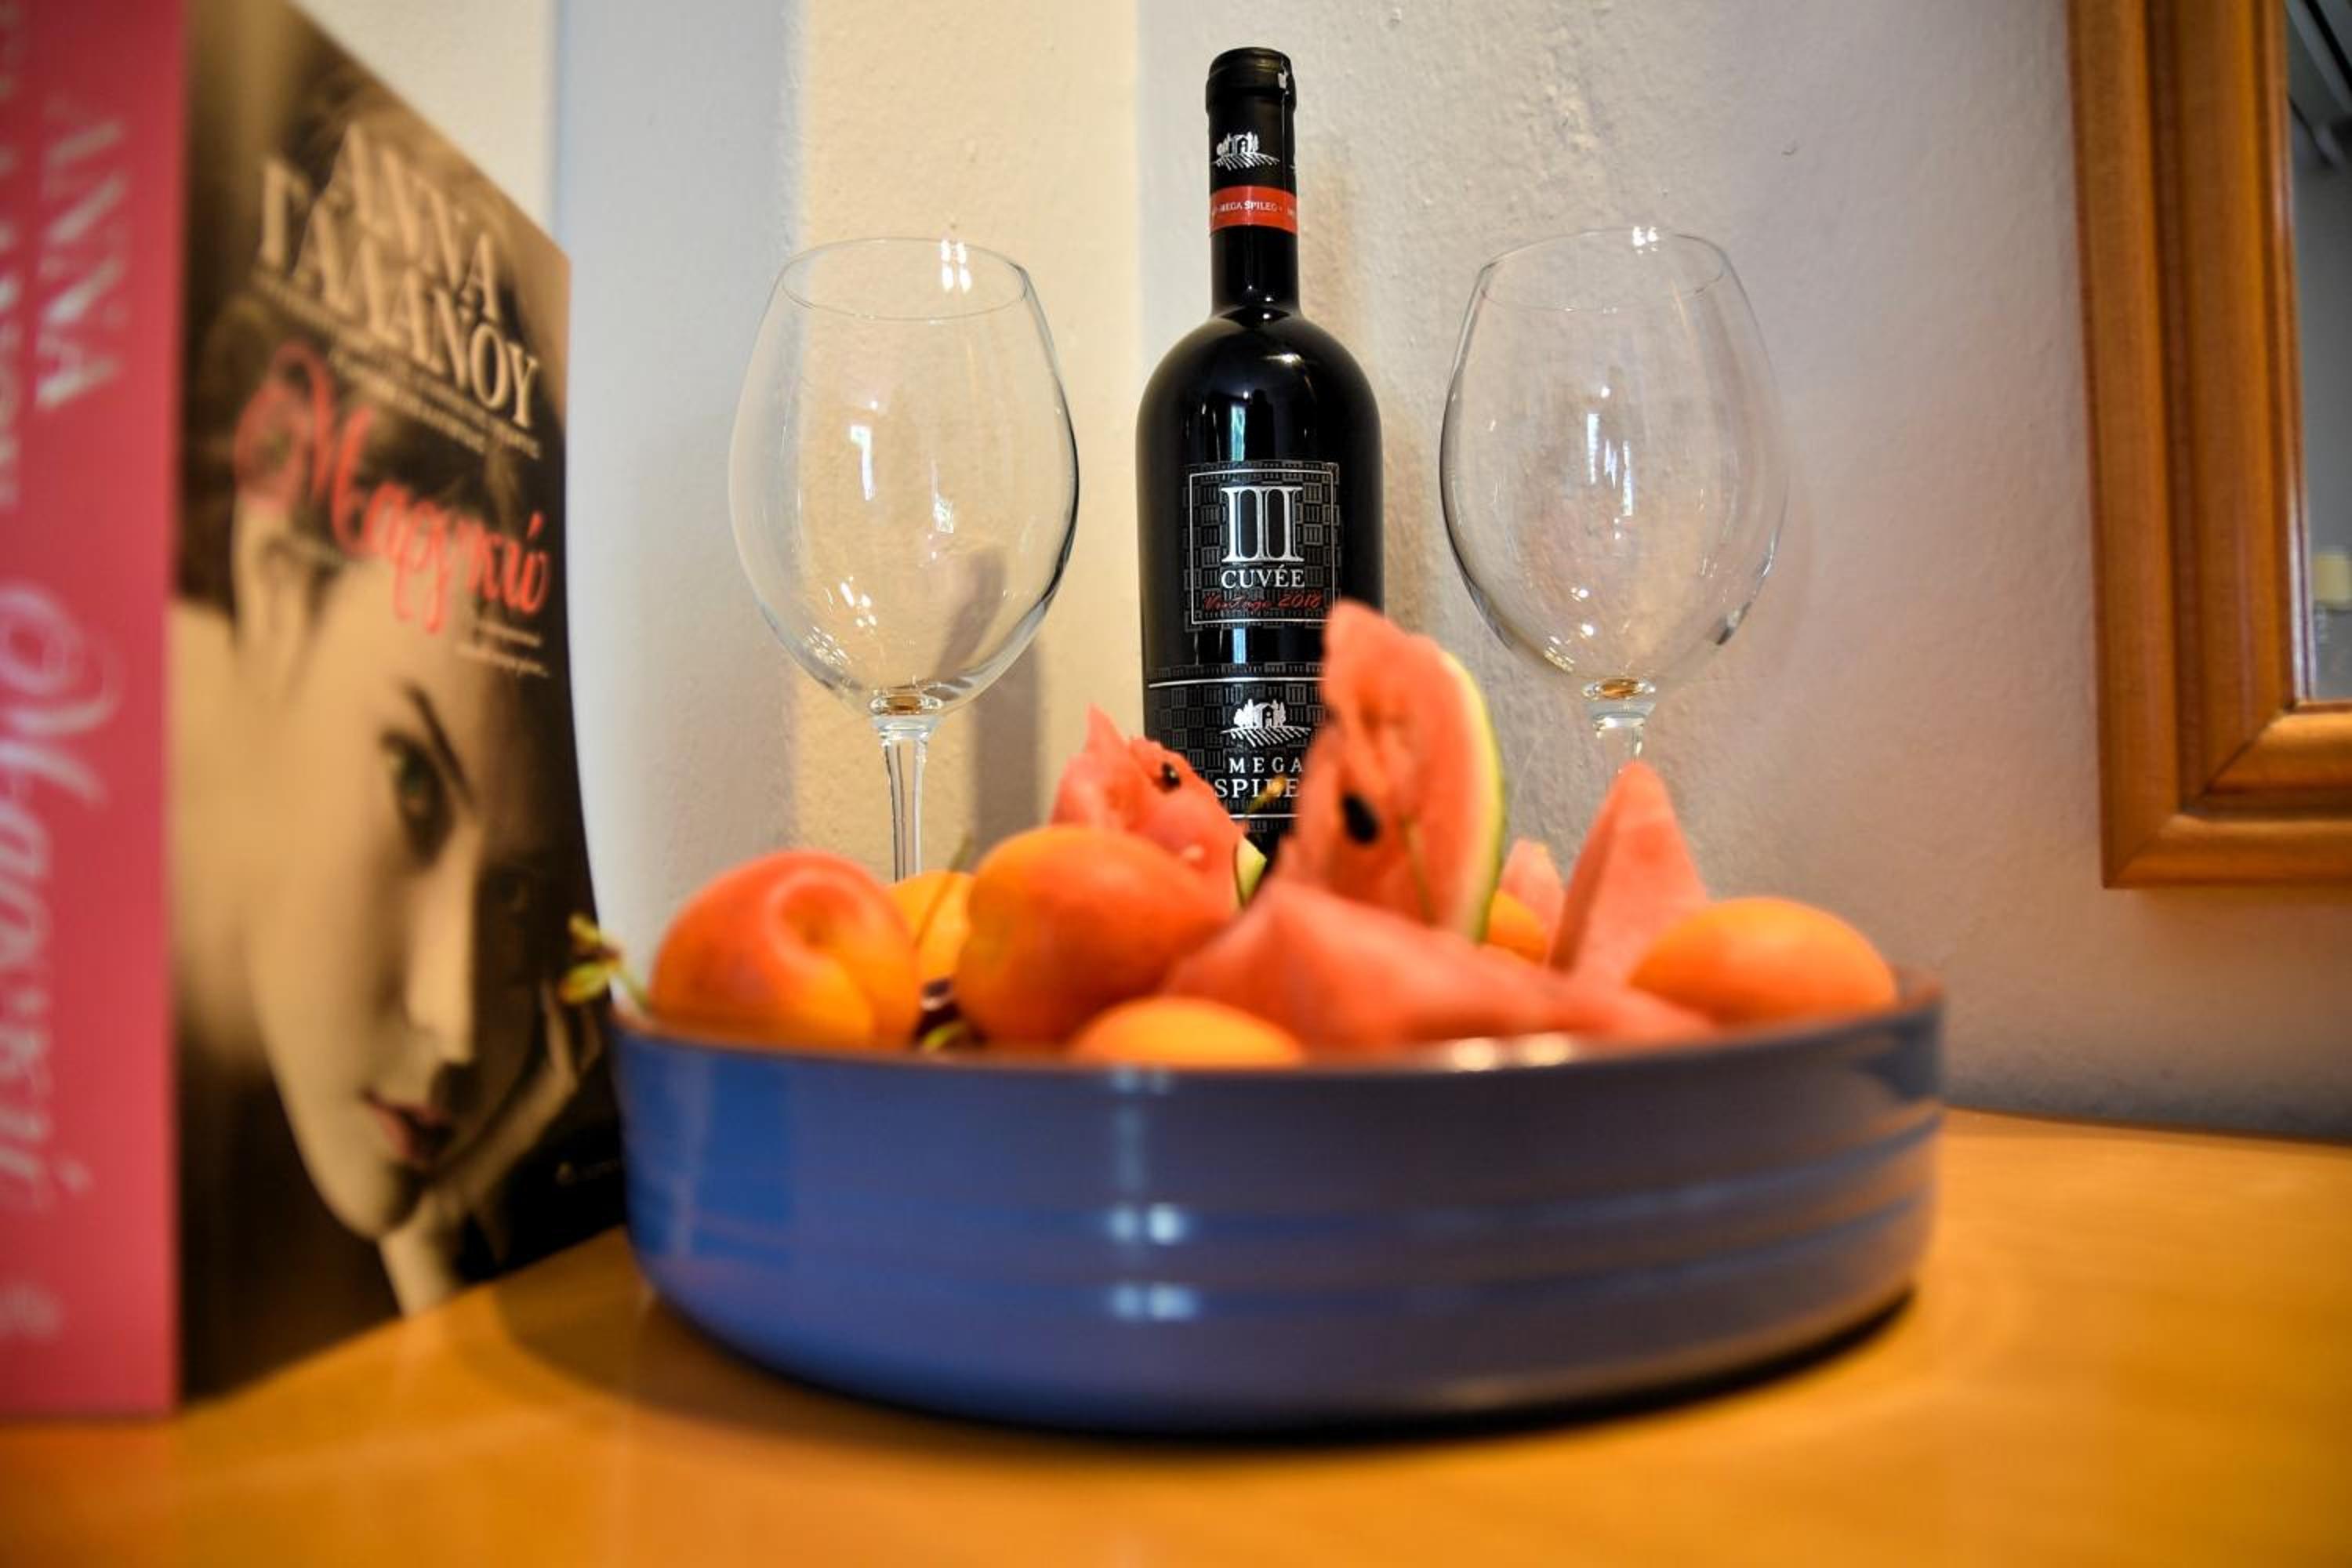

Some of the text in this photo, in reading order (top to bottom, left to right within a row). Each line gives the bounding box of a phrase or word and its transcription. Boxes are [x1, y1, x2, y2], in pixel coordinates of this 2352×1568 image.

[1221, 564, 1305, 589] CUVÉE
[1229, 757, 1304, 774] MEGA
[1214, 778, 1300, 798] SPIE
